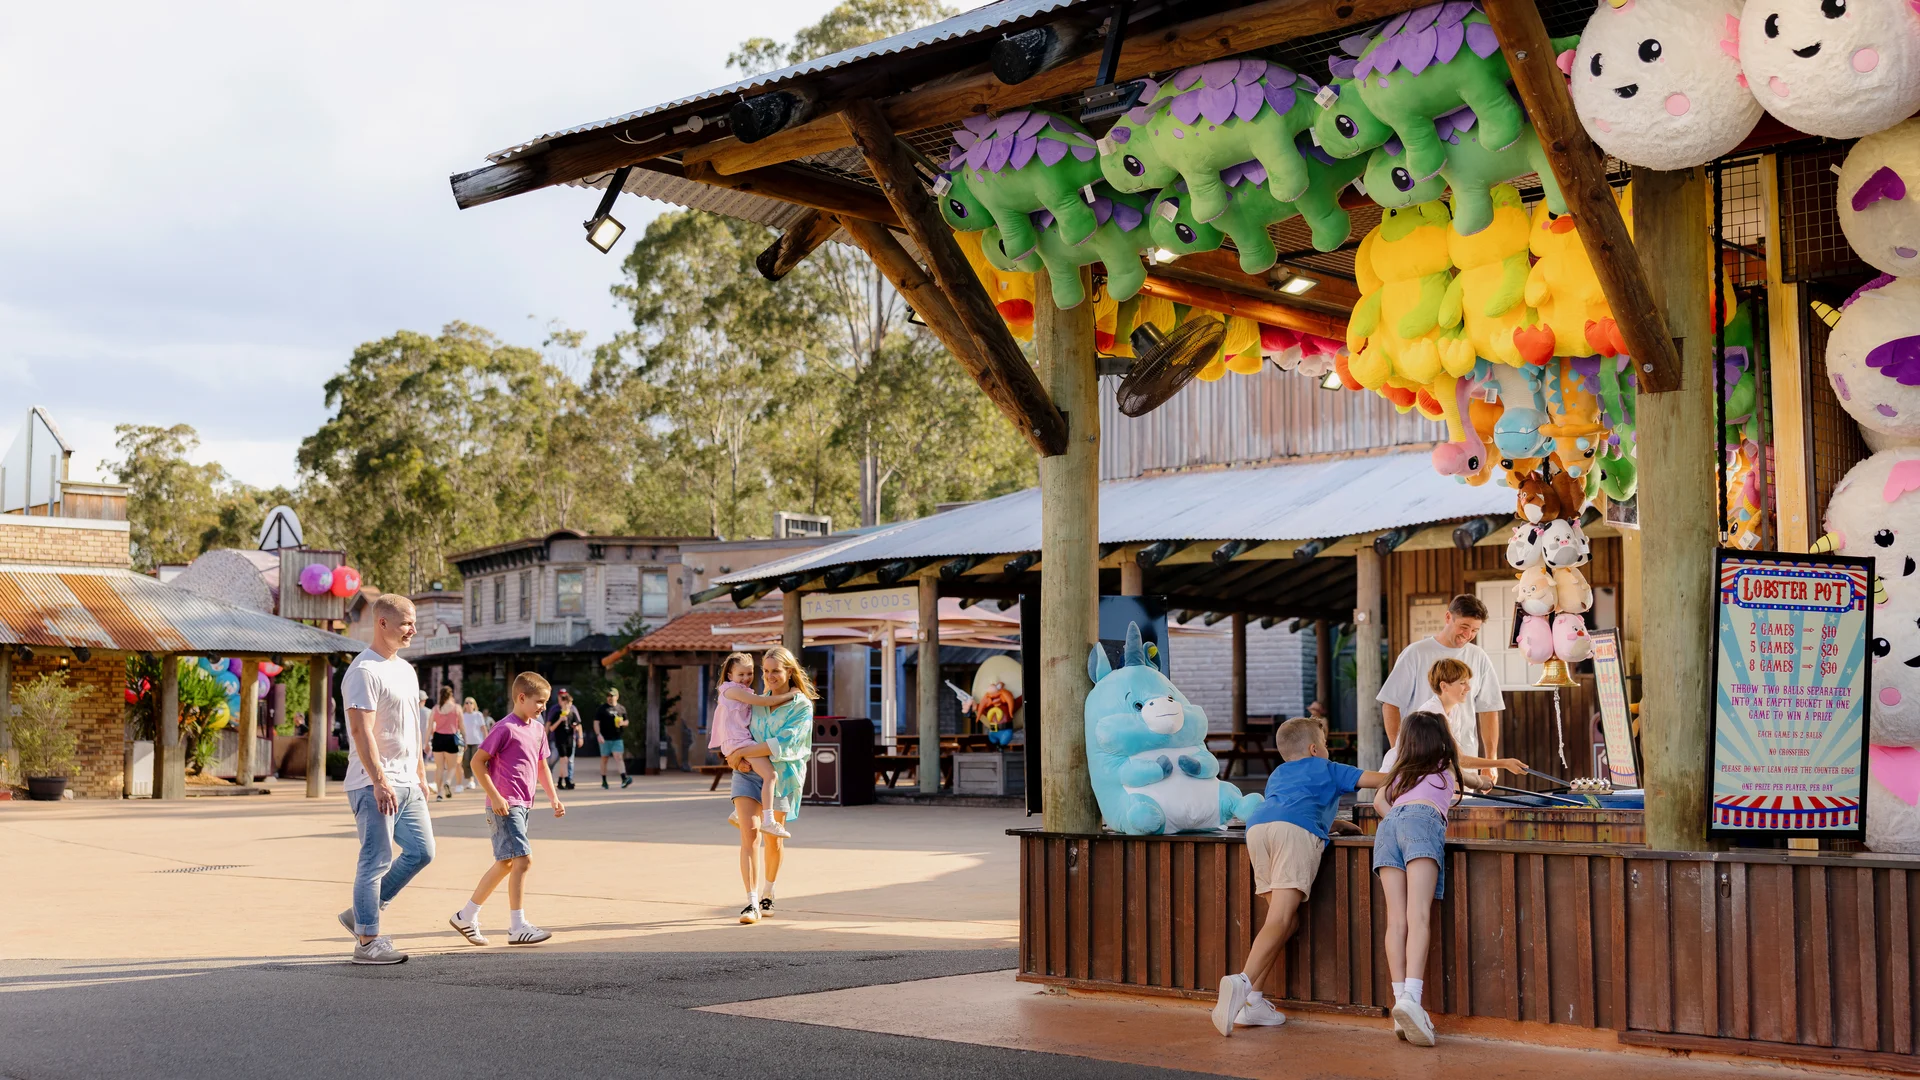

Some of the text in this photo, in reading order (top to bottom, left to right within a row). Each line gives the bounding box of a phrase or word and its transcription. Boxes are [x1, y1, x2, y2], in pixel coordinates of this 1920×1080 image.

[1742, 577, 1847, 605] LOBSTER POT
[806, 593, 910, 614] TASTY GOODS
[1750, 622, 1837, 642] 2 GAMES $10
[1750, 640, 1839, 660] 5 GAMES $20
[1749, 658, 1837, 678] 8 GAMES $30
[1731, 684, 1852, 697] THROW TWO BALLS SEPARATELY
[1731, 696, 1850, 709] INTO AN EMPTY BUCKET IN ONE
[1748, 709, 1833, 722] GAME TO WIN A PRIZE
[1757, 730, 1823, 740] EACH GAME IS 2 BALLS
[1768, 748, 1810, 757] NO CROSSFIRES
[1721, 764, 1855, 775] PLEASE DO NOT LEAN OVER THE COUNTER EDGE
[1741, 783, 1834, 792] ONE PRIZE PER PLAYER, PER DAY
